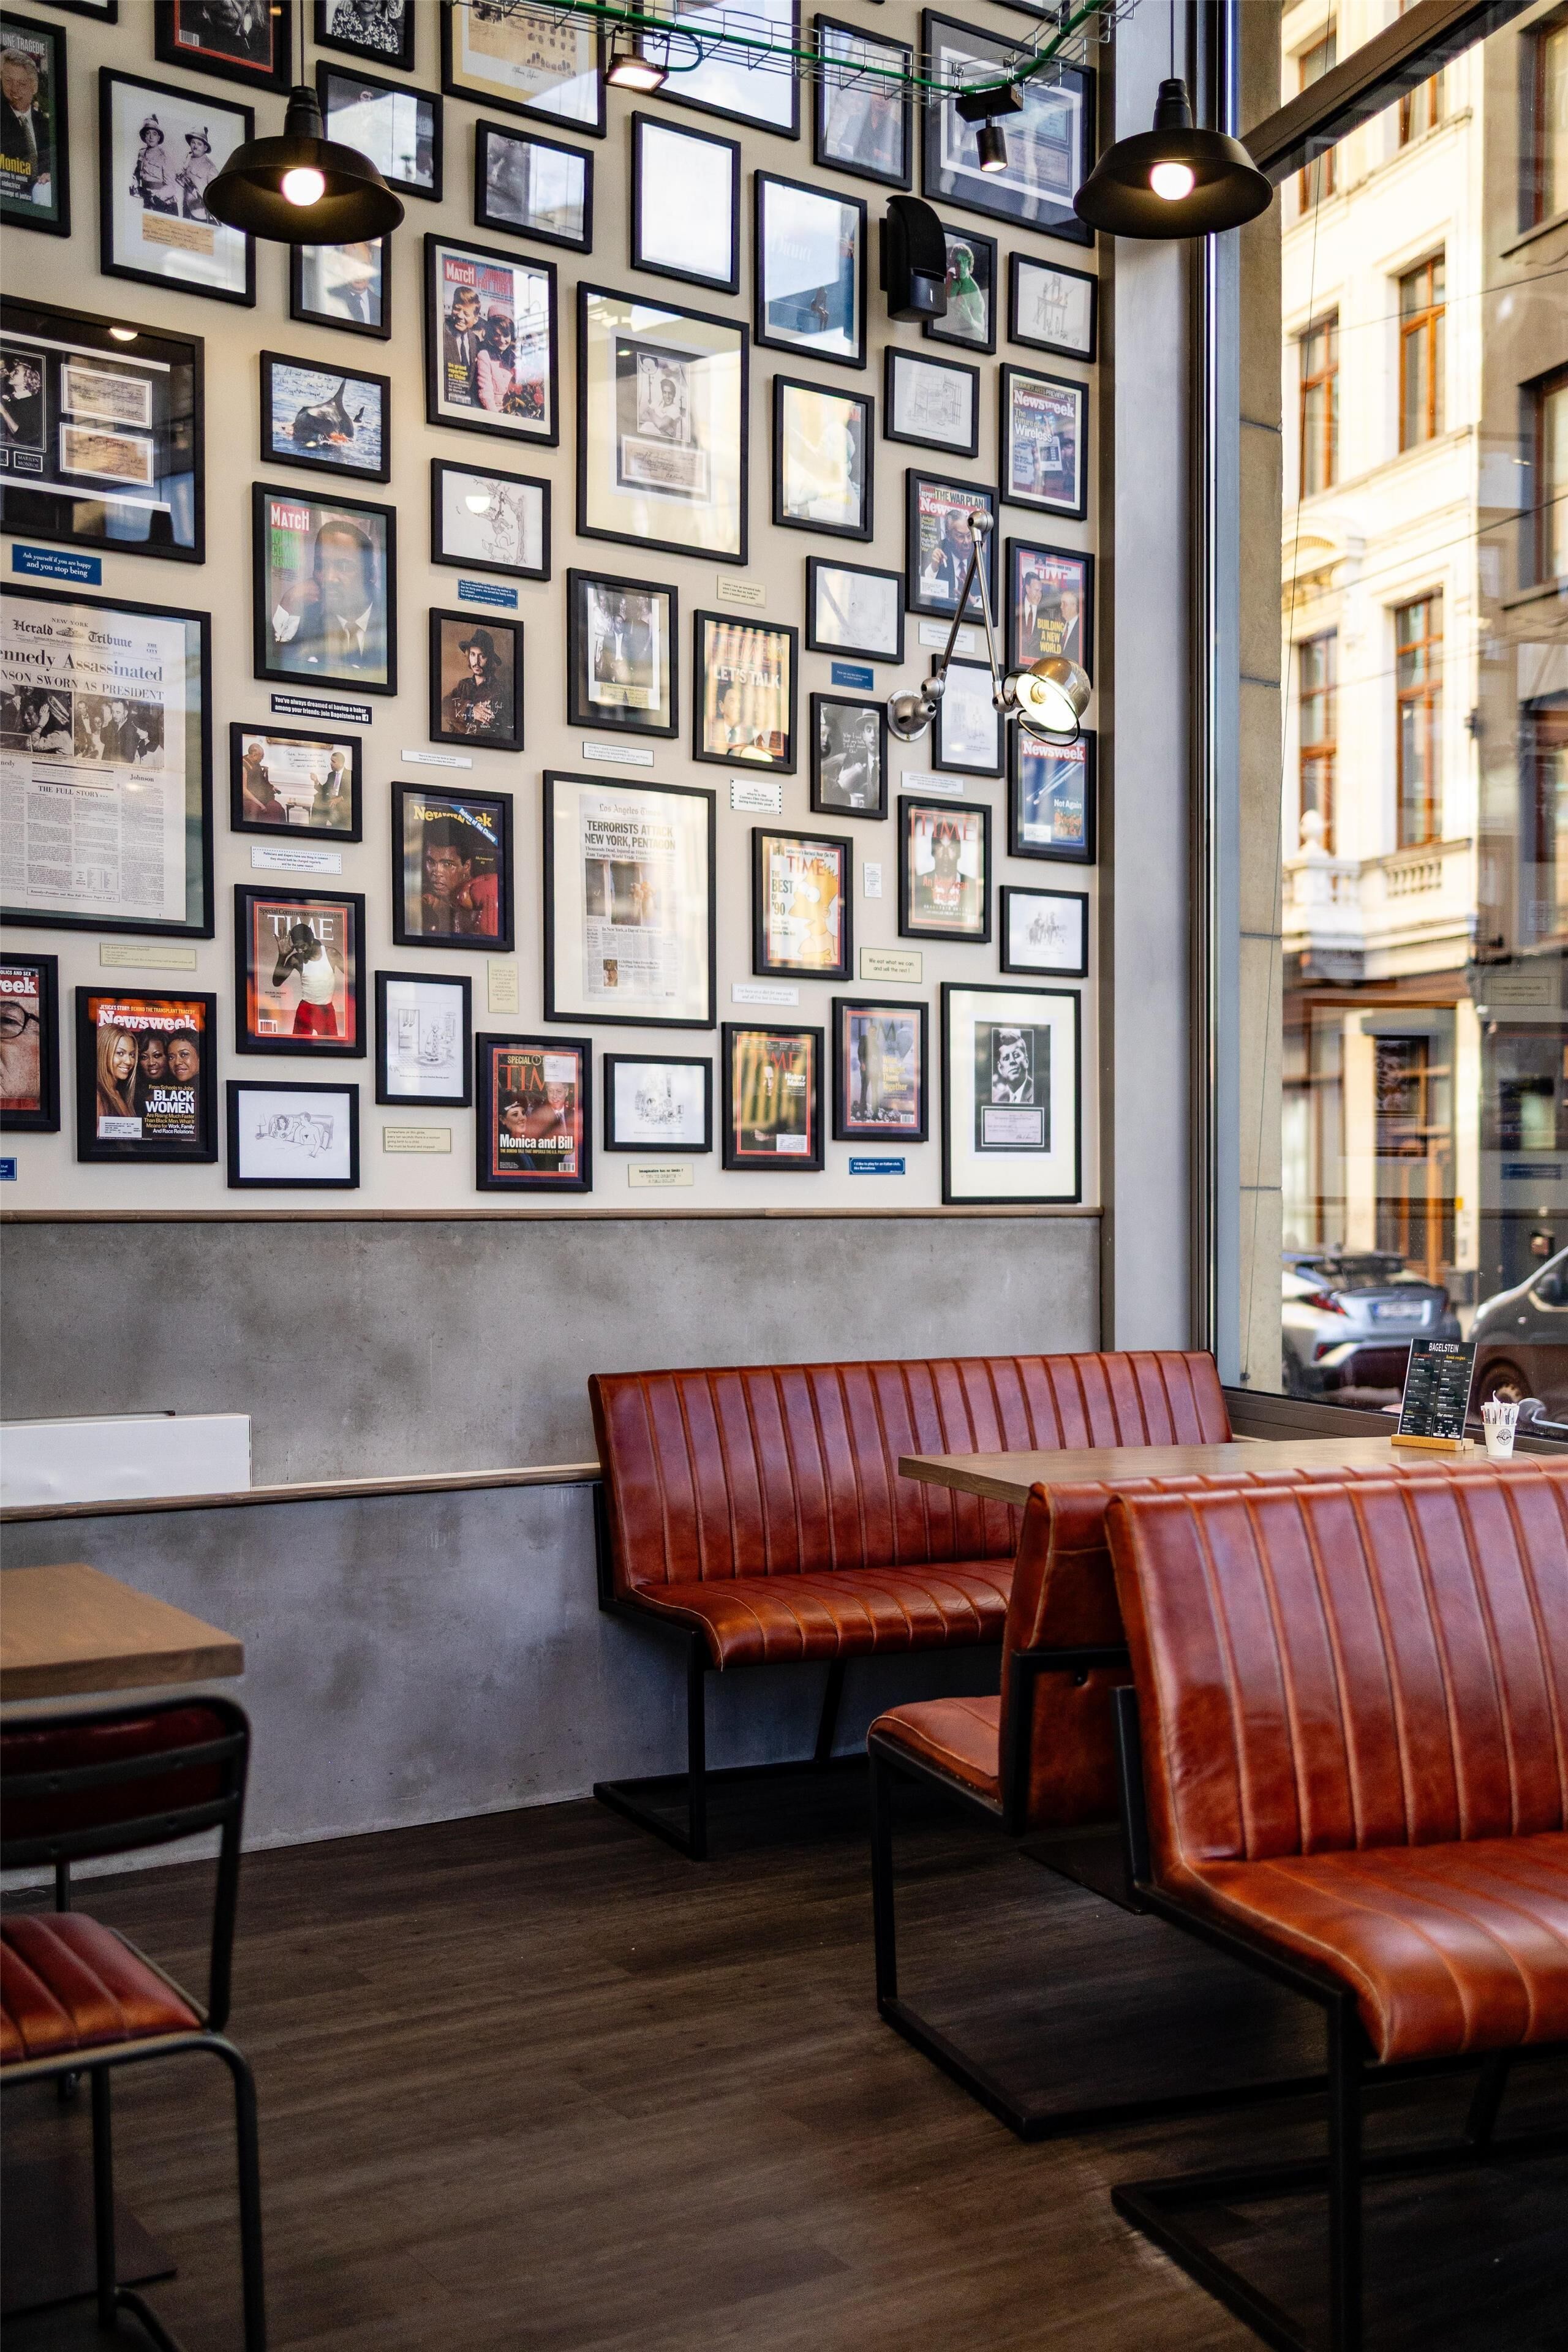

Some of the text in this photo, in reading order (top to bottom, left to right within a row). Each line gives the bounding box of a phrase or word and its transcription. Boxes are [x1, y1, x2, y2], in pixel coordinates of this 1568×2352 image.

[3, 34, 45, 56] UNE TRAGEDIE
[1046, 390, 1065, 399] PREVIEW
[1014, 390, 1074, 418] Newsweek
[1014, 408, 1027, 417] The
[1014, 415, 1034, 427] Future
[1014, 423, 1052, 442] Wireless
[936, 489, 984, 510] THE WAR PLAN
[271, 505, 309, 531] MATCH
[54, 566, 69, 575] stop
[70, 567, 88, 578] being
[77, 561, 92, 570] happy
[1037, 618, 1065, 633] BUILDING
[12, 619, 132, 648] Herald Tribune
[1041, 630, 1060, 643] A NEW
[1040, 641, 1062, 654] WORLD
[63, 653, 164, 682] Assassinated
[713, 664, 780, 689] LET'S TALK
[37, 675, 165, 701] SWORN AS PRESIDENT
[290, 698, 307, 707] always
[334, 704, 349, 713] having
[303, 707, 321, 716] friends:
[330, 710, 355, 720] Bagelstein
[1023, 740, 1084, 761] Newsweek
[130, 774, 154, 782] Johnson
[56, 786, 74, 795] FULL
[600, 804, 639, 815] Los Angeles
[1054, 799, 1082, 810] Not Again
[459, 807, 473, 824] Return
[483, 827, 496, 842] Champ
[587, 820, 673, 837] TERRORISTS ATTACK
[916, 813, 976, 841] TIME
[584, 833, 676, 851] NEW YORK, PENTAGON
[786, 856, 825, 876] TIME
[772, 879, 794, 894] BEST
[923, 875, 932, 887] An
[930, 888, 961, 903] Tragedy
[259, 907, 278, 916] Special
[279, 908, 323, 918] Commemorative
[772, 902, 786, 916] '90
[99, 1010, 197, 1031] Newsweek
[507, 1055, 532, 1065] SPECIAL
[882, 1054, 897, 1064] What
[785, 1072, 806, 1081] History
[883, 1072, 899, 1082] Them
[883, 1081, 908, 1092] Together
[154, 1090, 195, 1102] BLACK
[146, 1101, 194, 1114] WOMEN
[500, 1134, 573, 1149] Monica and Bill
[1428, 1343, 1459, 1353] BAGELSTEIN
